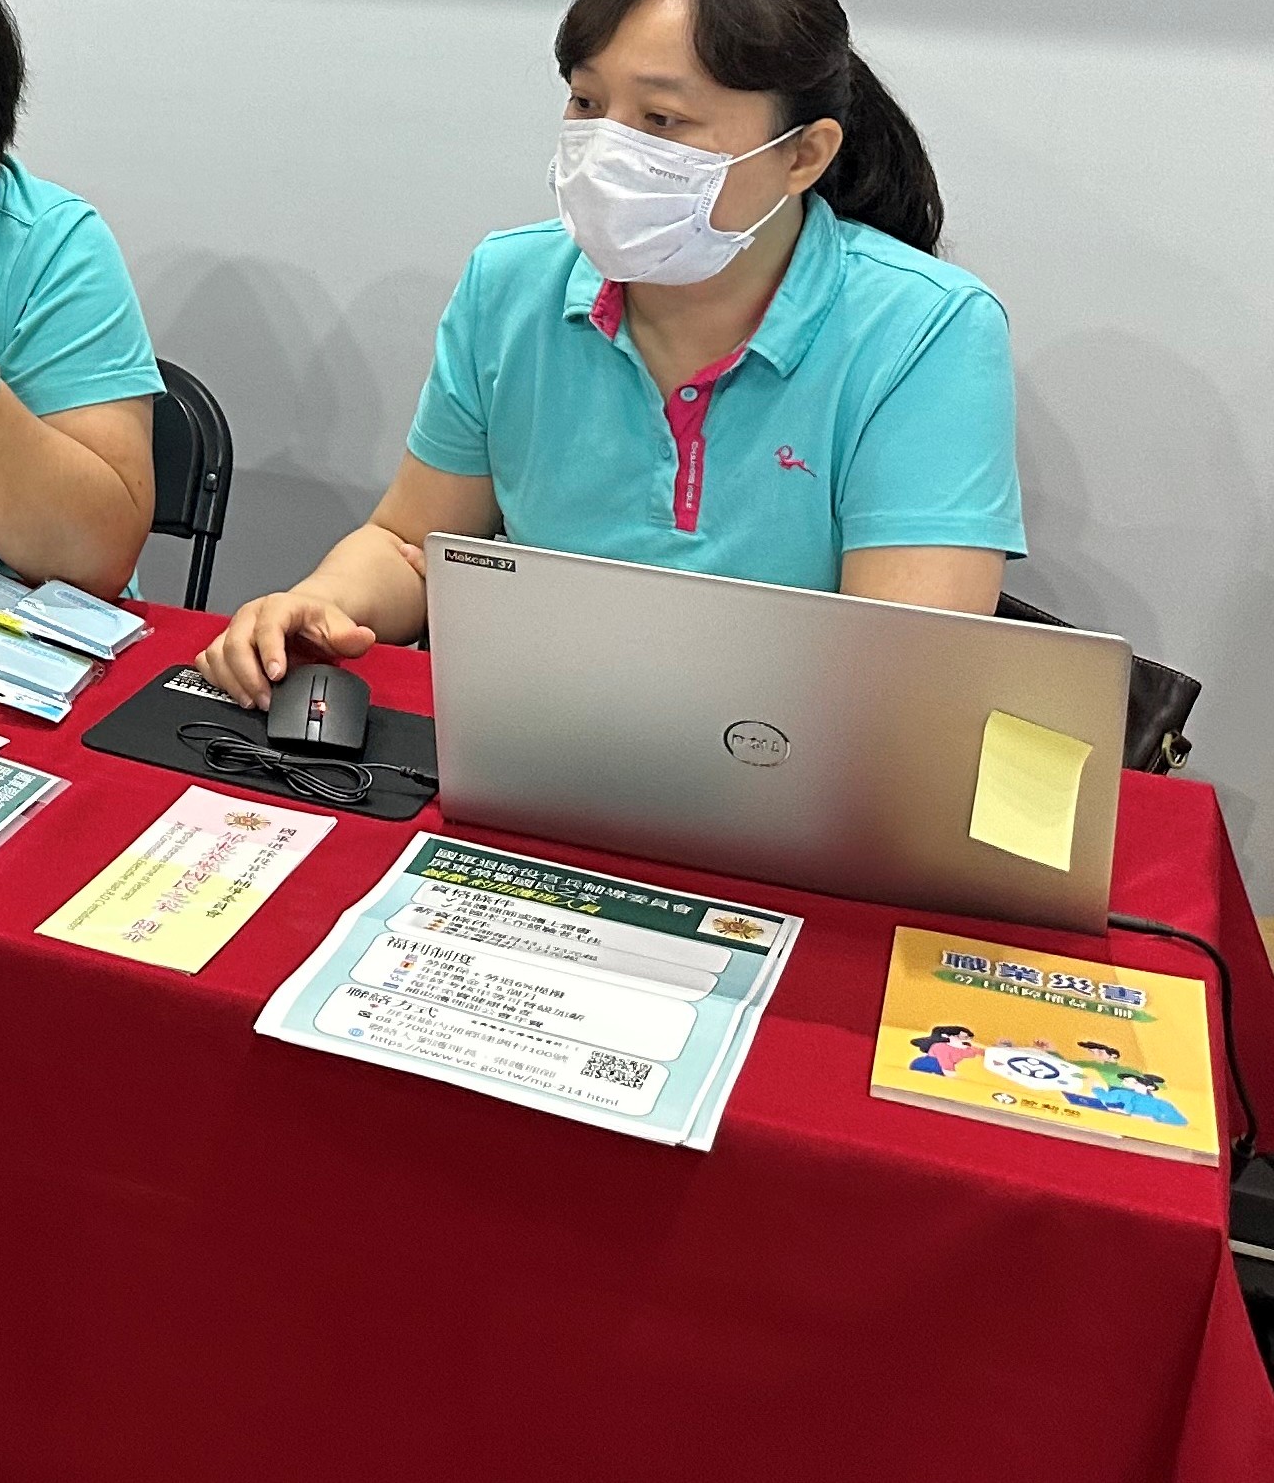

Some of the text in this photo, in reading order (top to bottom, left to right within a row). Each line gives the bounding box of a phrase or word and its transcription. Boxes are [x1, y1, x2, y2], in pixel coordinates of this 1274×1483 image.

[498, 560, 512, 569] 37
[387, 935, 476, 966] 福利制度
[942, 950, 1147, 1007] 職業災害
[346, 987, 439, 1019] 聯絡方式
